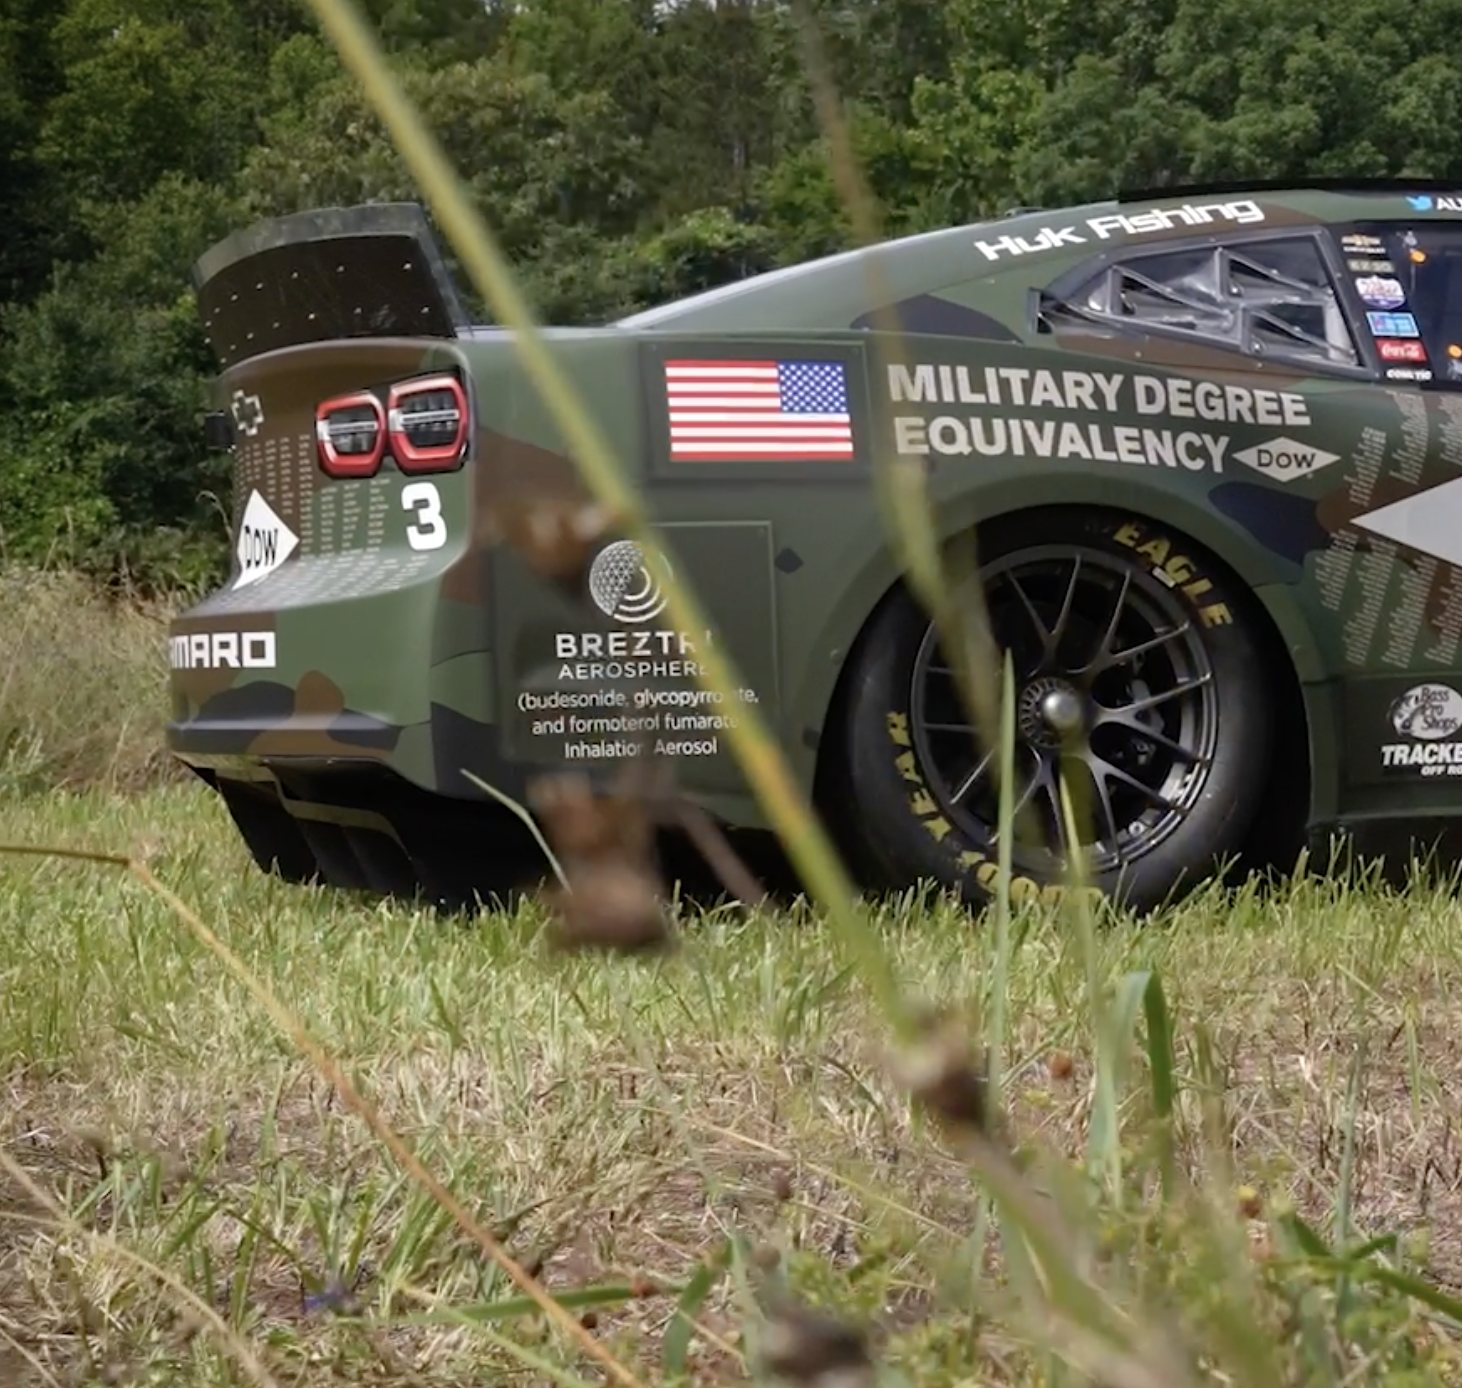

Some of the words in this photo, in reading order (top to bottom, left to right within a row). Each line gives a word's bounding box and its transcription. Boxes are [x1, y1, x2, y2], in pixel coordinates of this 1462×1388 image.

[974, 227, 1088, 261] Huk
[1085, 200, 1265, 239] Fishing
[887, 364, 1126, 413] MILITARY
[1135, 376, 1312, 426] DEGREE
[894, 416, 1230, 474] EQUIVALENCY
[401, 482, 448, 551] 3
[1112, 522, 1234, 628] EAGLE
[170, 632, 277, 669] MARO
[634, 687, 760, 710] glycopyrrote,
[532, 715, 565, 735] and
[569, 712, 661, 734] formoterol
[653, 736, 718, 756] Aerosol
[1421, 764, 1446, 776] OFF
